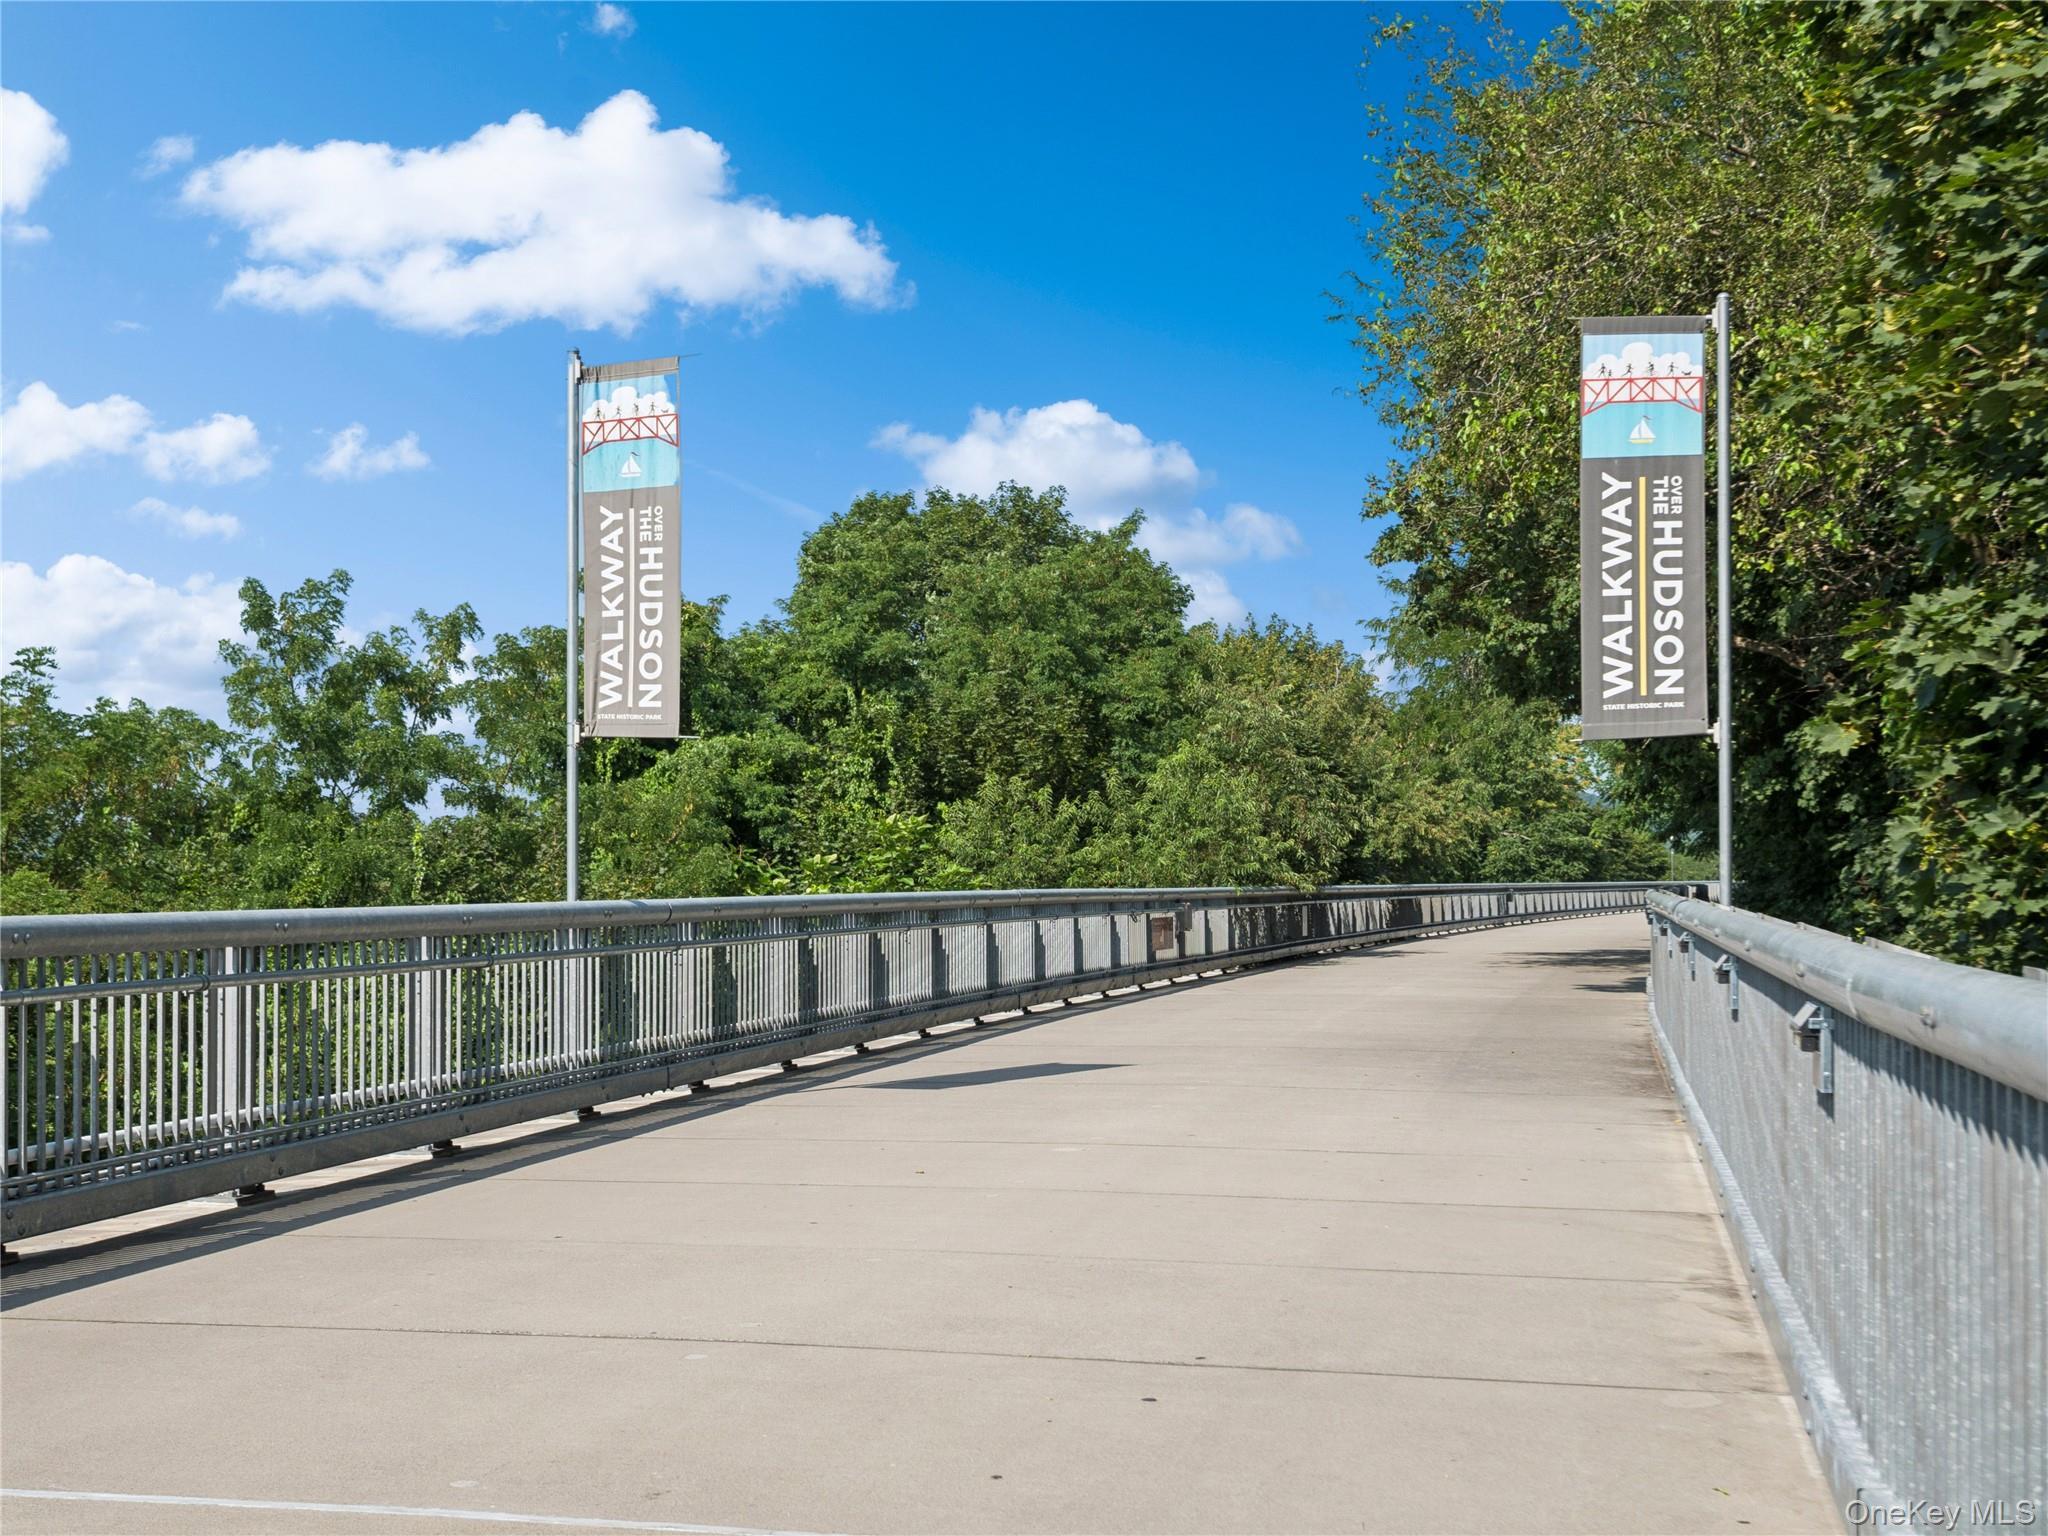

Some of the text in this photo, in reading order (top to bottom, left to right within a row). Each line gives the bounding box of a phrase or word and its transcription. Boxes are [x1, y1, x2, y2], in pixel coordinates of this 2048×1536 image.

[1653, 475, 1668, 515] THE
[1670, 475, 1683, 515] OVER
[639, 506, 652, 542] THE
[654, 505, 663, 541] OVER
[1601, 472, 1634, 699] WALKWAY
[598, 505, 625, 709] WALKWAY
[1653, 520, 1685, 695] HUDSON
[638, 547, 664, 708] HUDSON
[1603, 703, 1626, 711] STATE
[1627, 702, 1663, 710] HISTORIC
